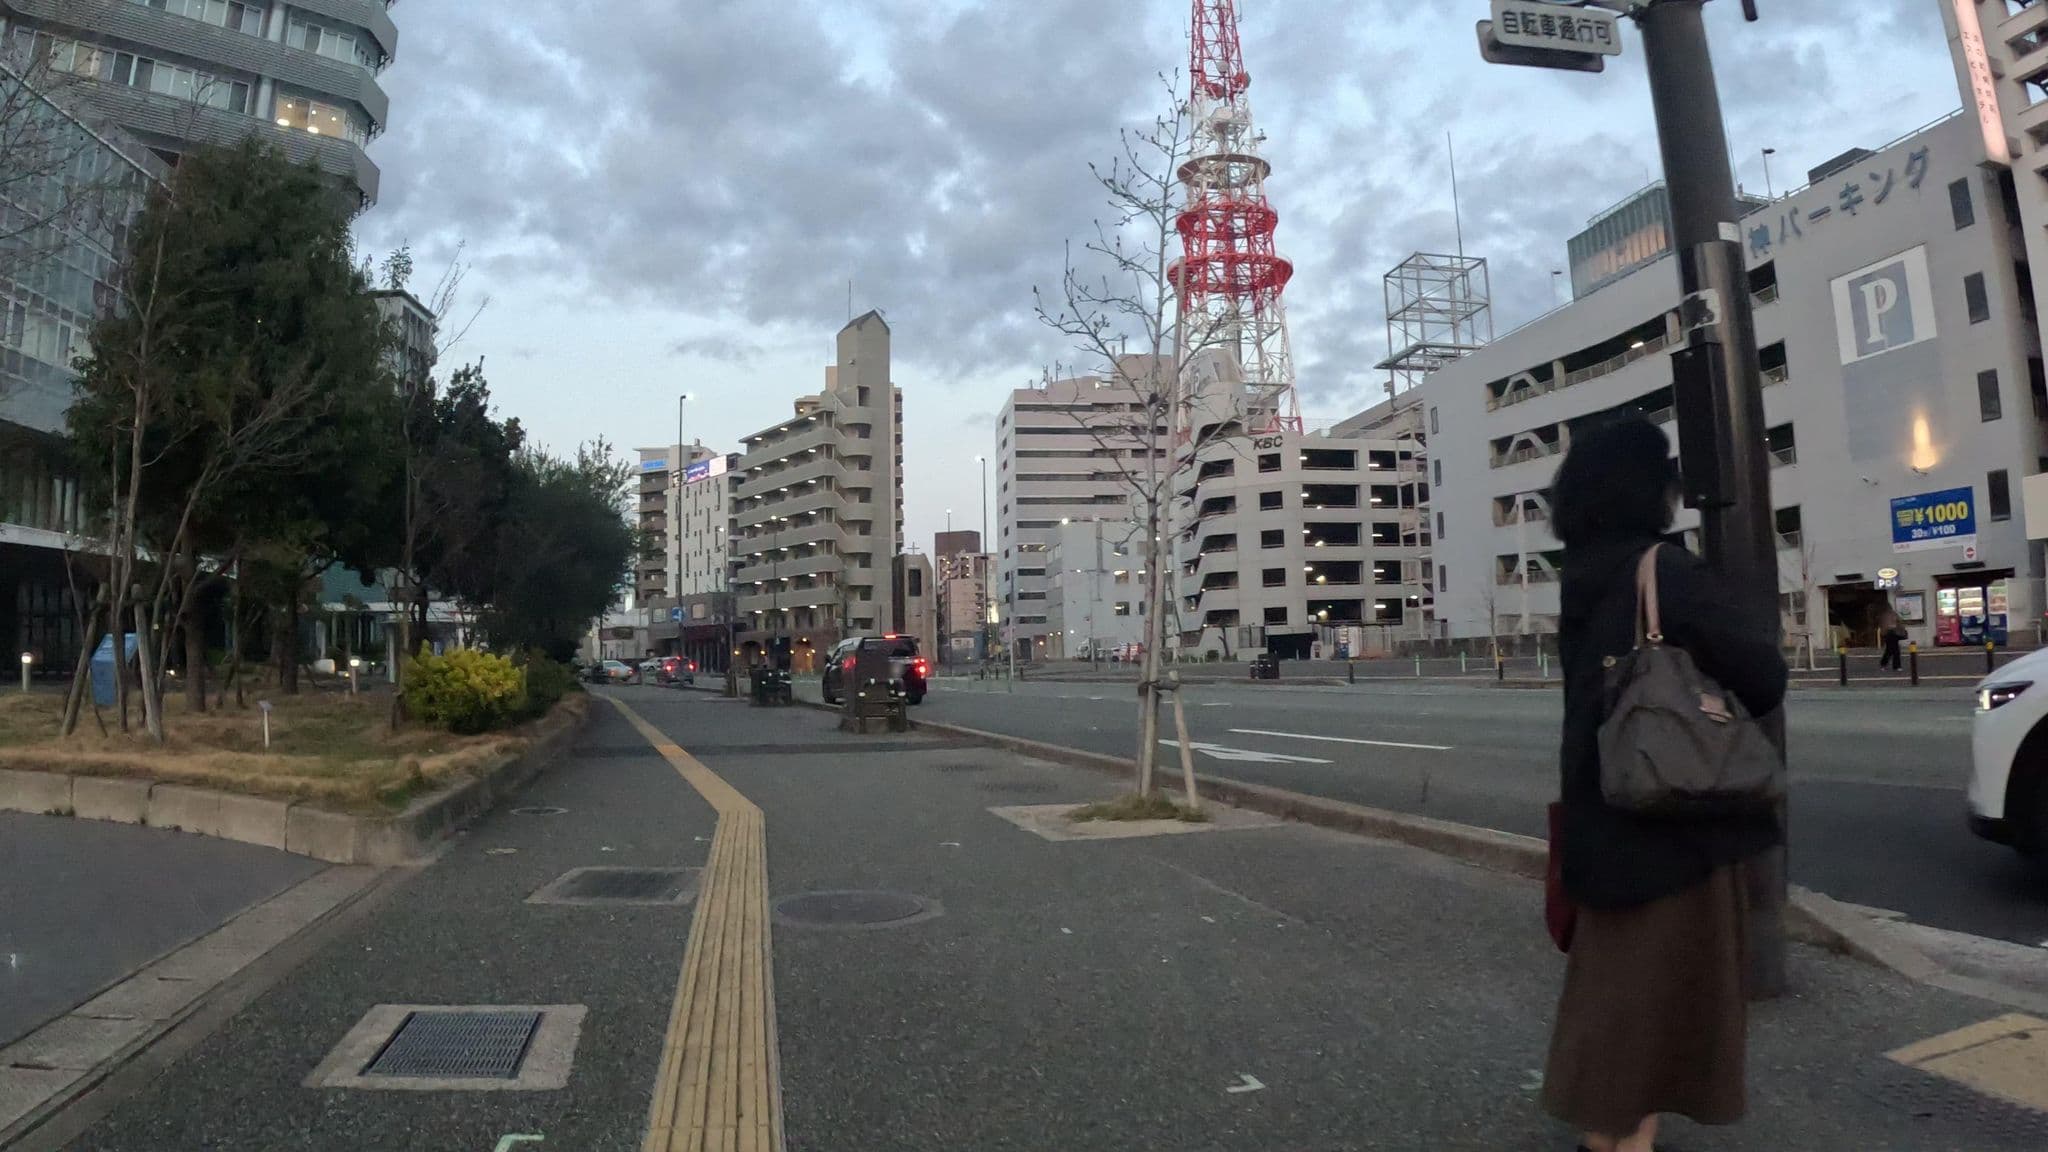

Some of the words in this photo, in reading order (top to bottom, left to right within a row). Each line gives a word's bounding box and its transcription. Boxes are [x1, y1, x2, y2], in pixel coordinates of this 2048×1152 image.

[1502, 10, 1612, 45] 自転車通行可
[1859, 277, 1898, 344] P
[1253, 435, 1283, 450] KBC
